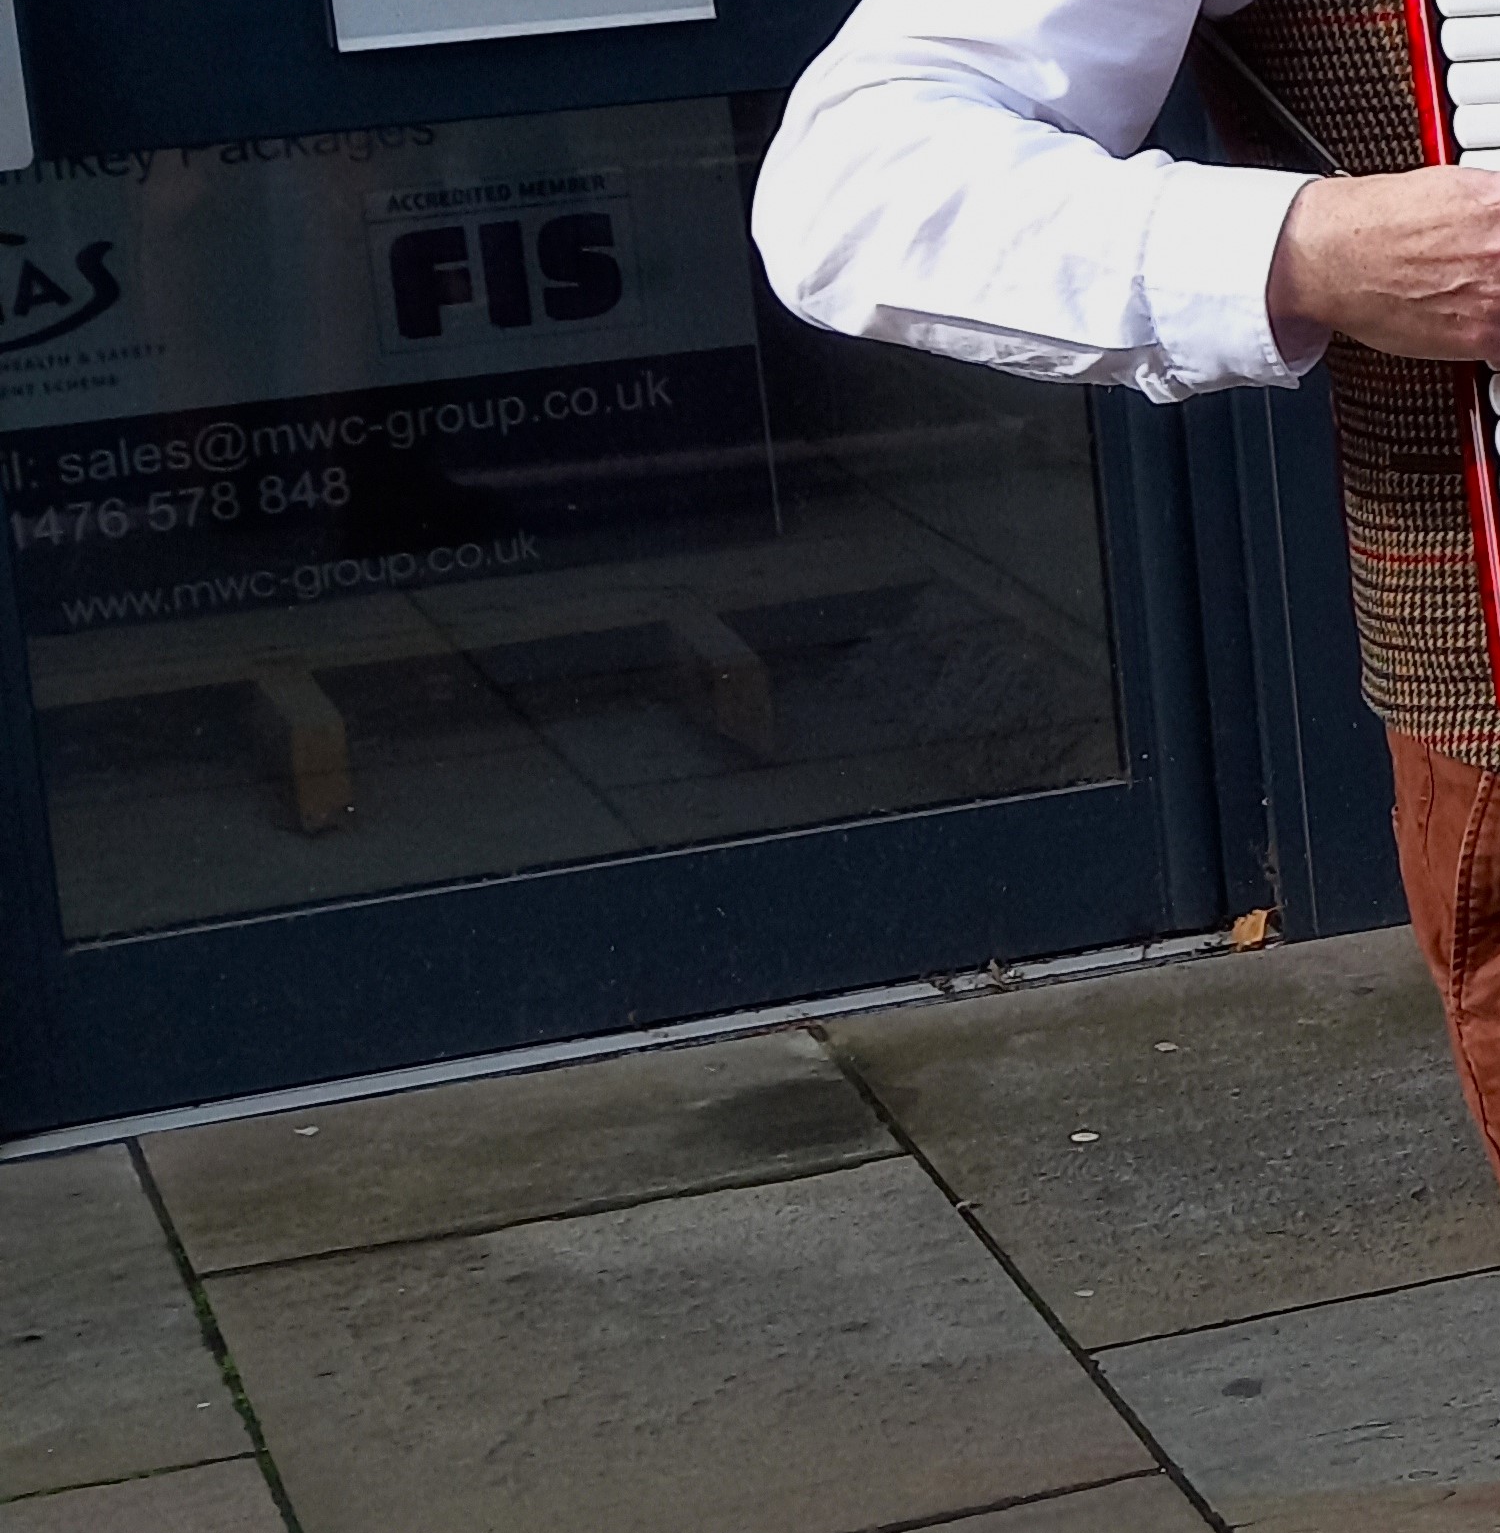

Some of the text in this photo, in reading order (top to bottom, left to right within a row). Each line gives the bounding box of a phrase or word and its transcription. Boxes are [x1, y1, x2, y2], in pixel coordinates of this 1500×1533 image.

[387, 174, 606, 213] ACCREDITED MEMBER
[390, 213, 622, 339] FIS
[57, 369, 673, 487] sales@mwc-group.co.uk
[147, 479, 241, 532] 578
[257, 466, 352, 516] 848
[62, 528, 541, 627] www.mwc-group.co.uk
